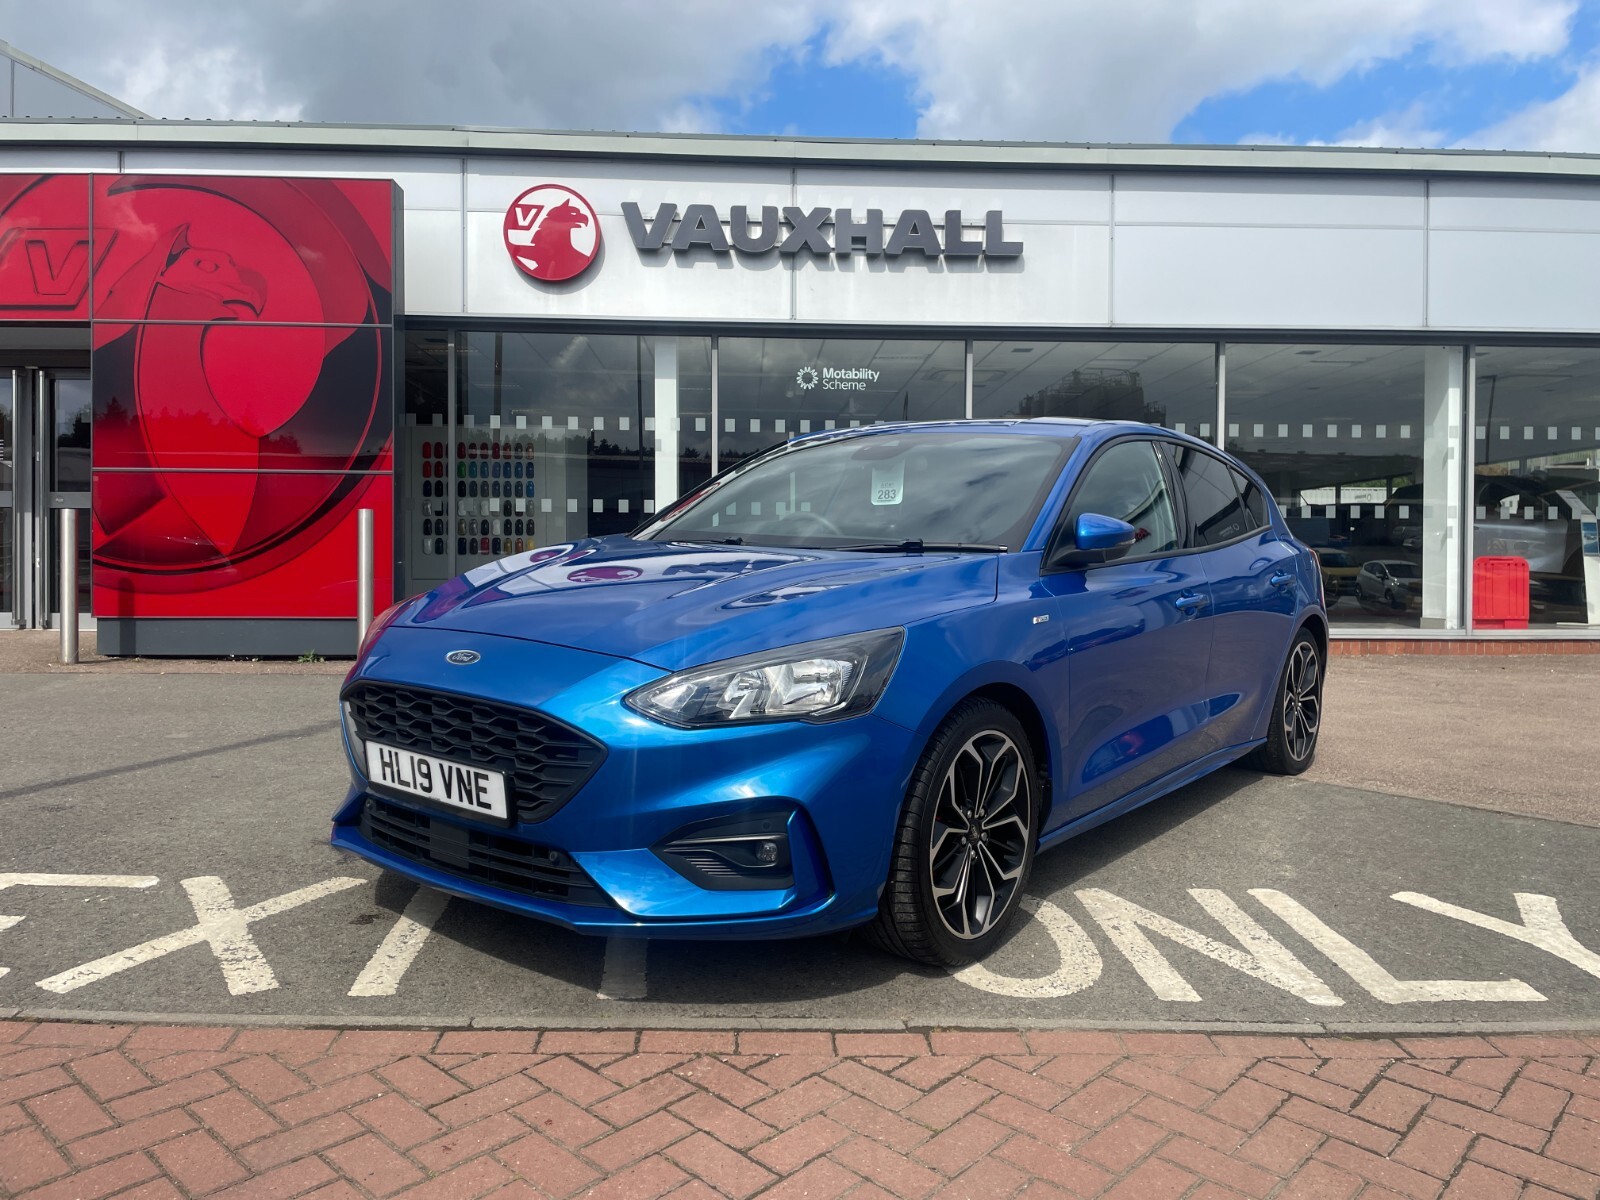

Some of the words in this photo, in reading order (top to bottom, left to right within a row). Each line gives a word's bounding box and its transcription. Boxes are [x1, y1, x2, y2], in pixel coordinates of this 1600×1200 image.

[515, 207, 538, 227] V
[621, 201, 1024, 256] VAUXHALL
[822, 367, 880, 382] Motability
[822, 379, 867, 390] Scheme
[877, 489, 897, 500] 283
[379, 747, 433, 794] HL19
[439, 762, 492, 811] VNE
